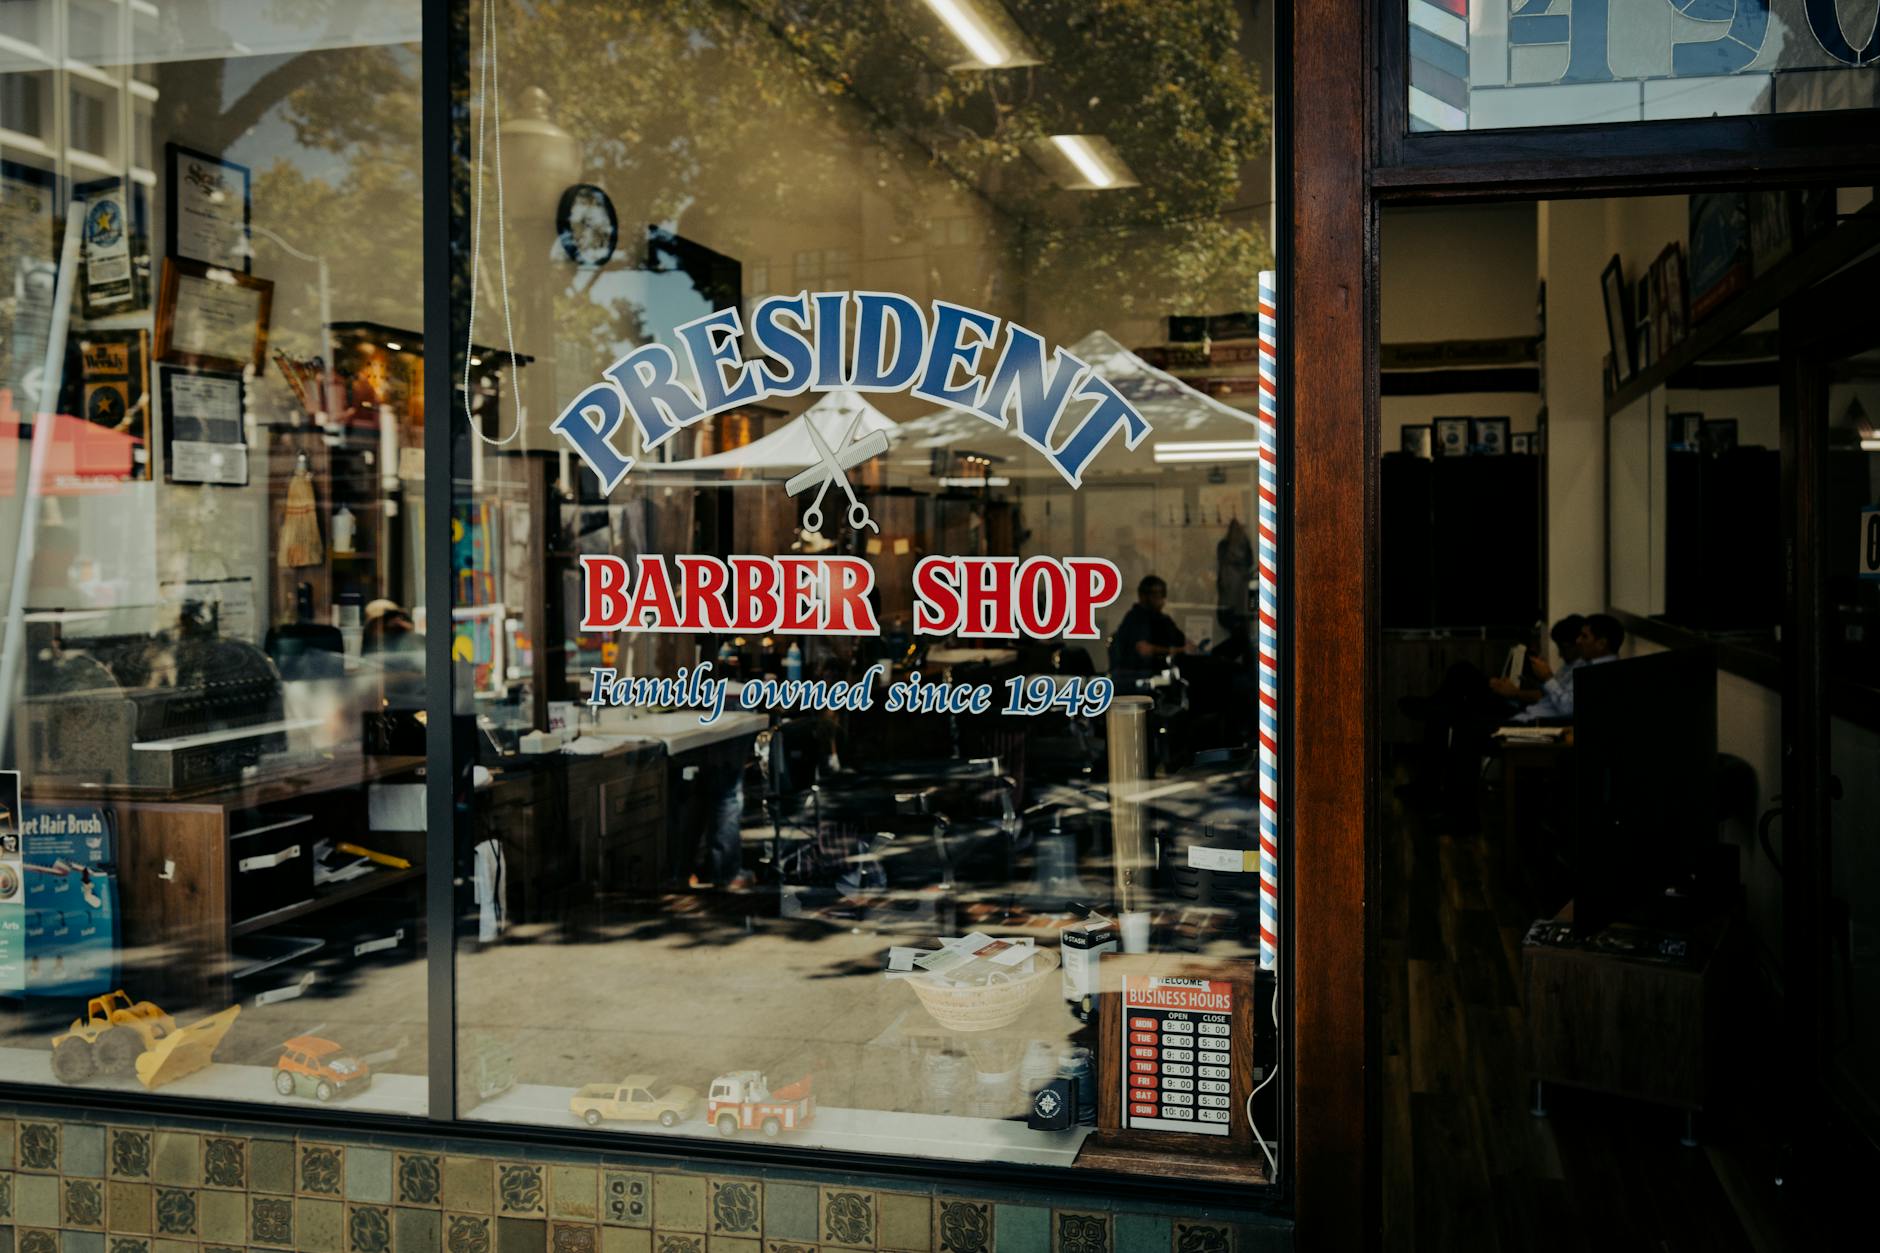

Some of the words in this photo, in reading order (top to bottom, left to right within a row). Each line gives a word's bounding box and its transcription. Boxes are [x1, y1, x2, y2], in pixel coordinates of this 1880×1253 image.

[549, 289, 1153, 496] PRESIDENT
[580, 554, 880, 637] BARBER
[912, 555, 1122, 640] SHOP
[587, 661, 730, 726] Family
[740, 664, 885, 714] owned
[887, 671, 992, 716] since
[1001, 674, 1115, 718] 1949
[40, 814, 66, 835] Hair
[68, 813, 102, 835] Brush
[1068, 935, 1086, 945] STASH
[1129, 988, 1187, 1007] BUSINESS
[1189, 992, 1231, 1009] HOURS
[1168, 1012, 1188, 1020] OPEN
[1202, 1014, 1226, 1023] CLOSE
[1135, 1020, 1152, 1028] MON
[1136, 1034, 1152, 1042] TUE
[1135, 1048, 1153, 1057] WED
[1136, 1063, 1152, 1071] THU
[1137, 1077, 1150, 1085] FRI
[1135, 1091, 1152, 1100] SAT
[1135, 1106, 1152, 1114] SUN
